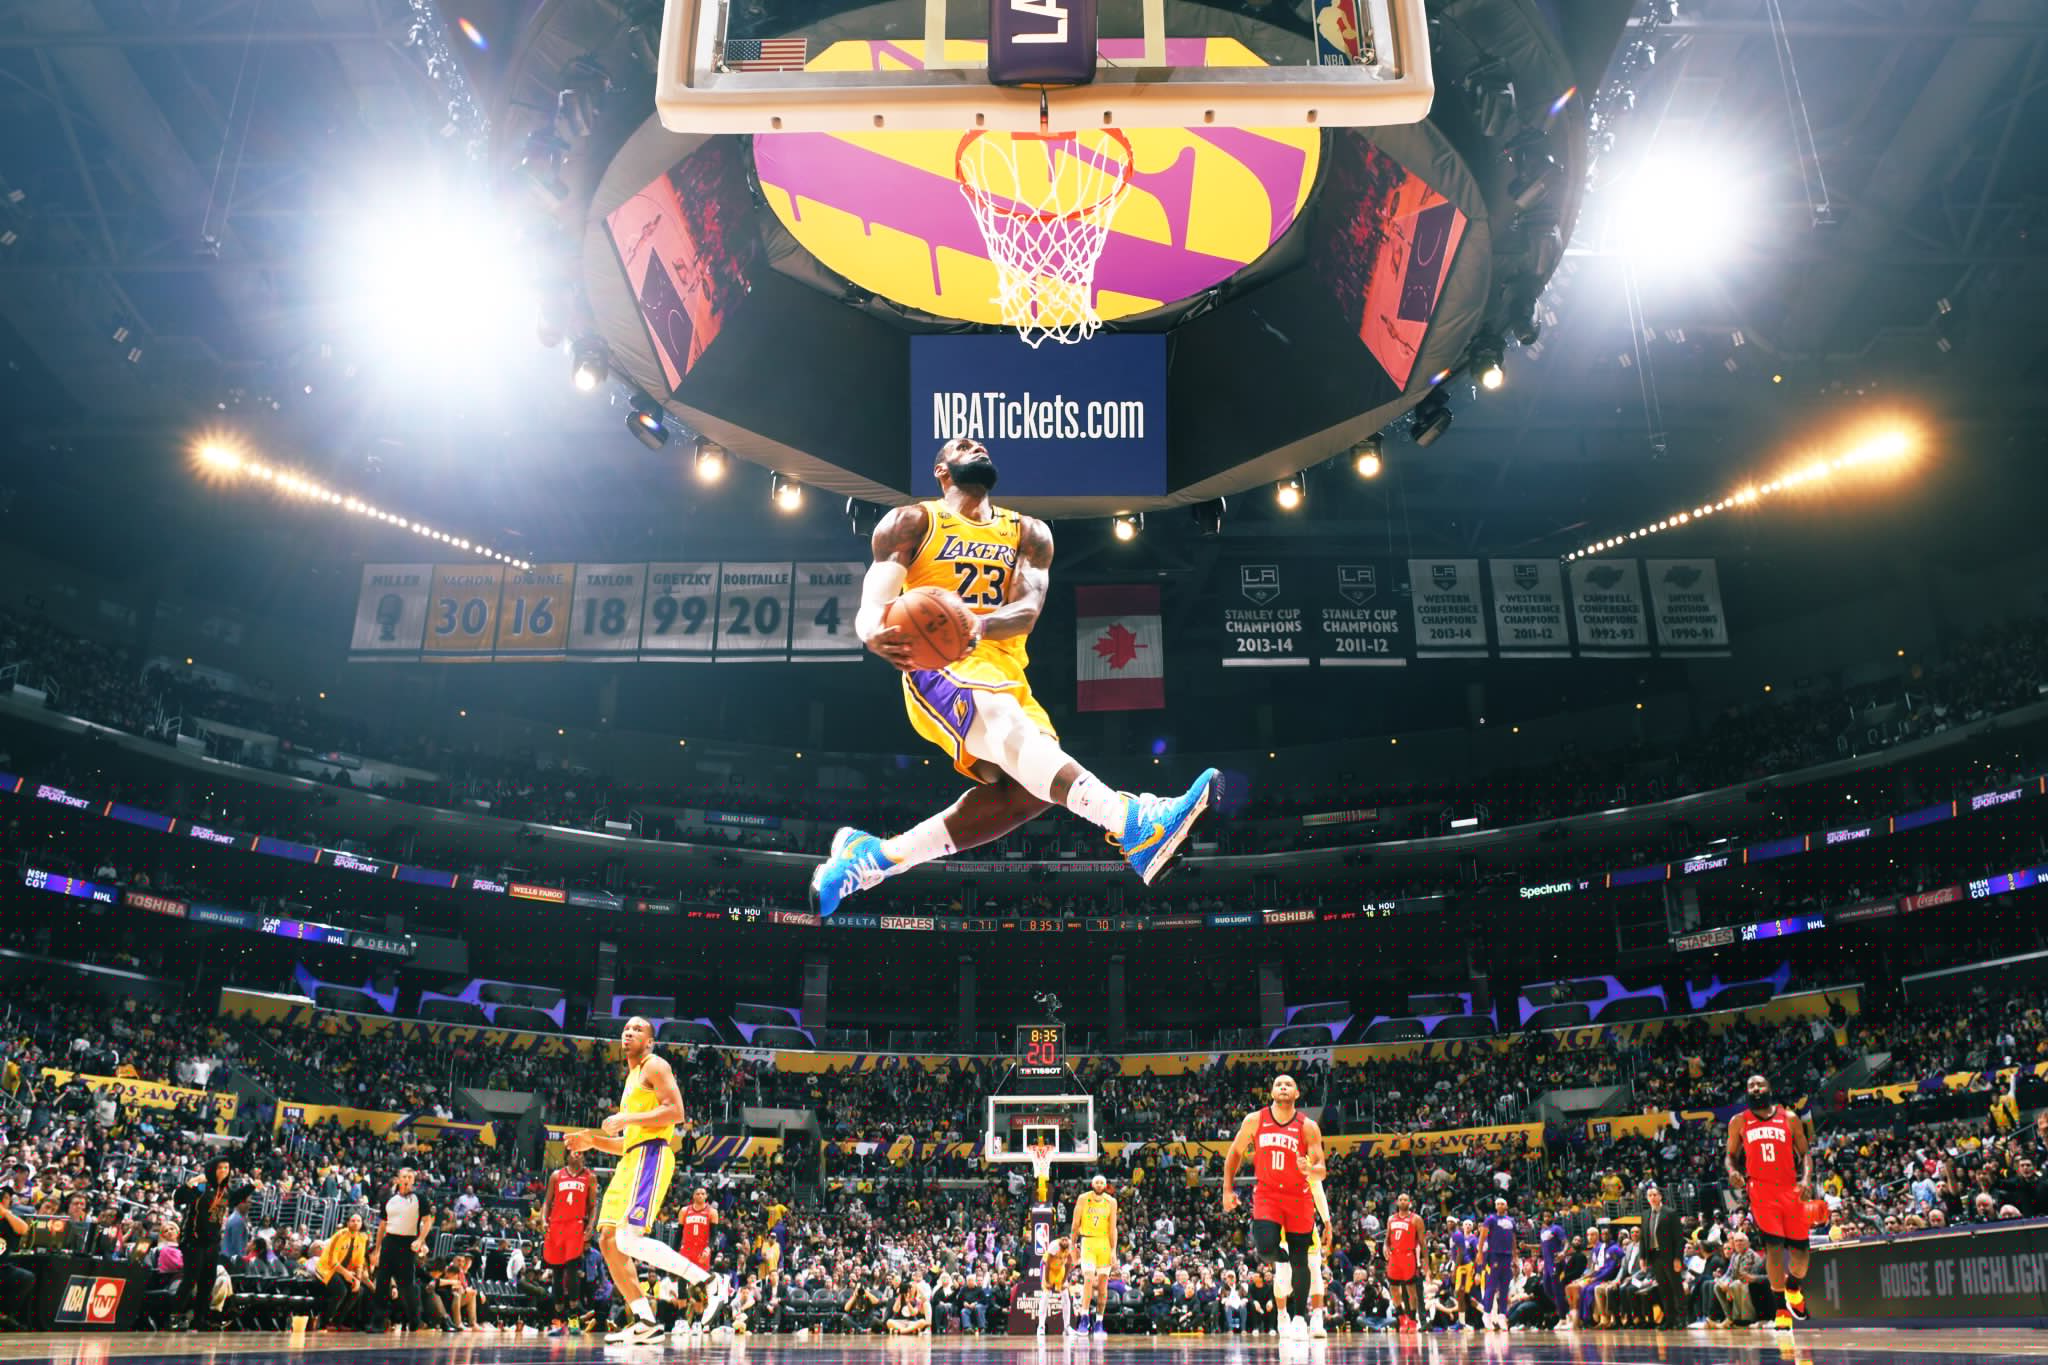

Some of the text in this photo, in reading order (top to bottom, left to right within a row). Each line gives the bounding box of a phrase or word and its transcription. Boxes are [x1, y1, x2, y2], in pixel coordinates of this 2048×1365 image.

[933, 392, 1144, 440] NBATickets.com
[935, 536, 1016, 568] LAKERS
[442, 575, 493, 585] VACHON
[587, 575, 633, 586] TAYLOR
[653, 574, 712, 585] GRETZKY
[724, 574, 789, 585] ROBITAILLE
[810, 574, 853, 585] BLAKE
[1245, 569, 1276, 582] LA
[1342, 569, 1372, 582] LA
[955, 562, 1005, 605] 23
[1423, 594, 1470, 604] WESTERN
[1505, 594, 1552, 603] WESTERN
[1224, 608, 1301, 620] STANLEY CUP
[1322, 608, 1397, 620] STANLEY CUP
[1417, 604, 1480, 614] CONFERENCE
[1500, 604, 1561, 614] CONFERENCE
[1579, 604, 1640, 614] CONFERENCE
[435, 597, 489, 635] 30
[512, 596, 554, 636] 16
[583, 597, 626, 635] 18
[652, 596, 708, 635] 99
[726, 596, 781, 635] 20
[814, 596, 840, 635] 4
[1422, 615, 1478, 625] CHAMPIONS
[1504, 615, 1560, 625] CHAMPIONS
[1583, 615, 1638, 625] CHAMPIONS
[1663, 615, 1718, 625] CHAMPIONS
[1225, 620, 1303, 632] CHAMPIONS
[1323, 620, 1399, 632] CHAMPIONS
[1430, 628, 1472, 639] 2013-14
[1514, 628, 1552, 640] 2011-12
[1591, 628, 1634, 640] 1992-93
[1671, 628, 1714, 640] 1990-91
[1236, 638, 1294, 652] 2013-14
[1336, 638, 1390, 652] 2011-12
[37, 789, 90, 809] SPORTSNET
[1972, 789, 2022, 810] SPORTSNET
[190, 830, 235, 845] SPORTSNET
[1826, 829, 1871, 845] SPORTSNET
[333, 857, 380, 875] SPORTSNET
[1684, 858, 1728, 874] SPORTSNET
[27, 869, 48, 881] NSH
[1520, 882, 1571, 899] Spectrum
[1969, 879, 1989, 890] NSH
[93, 891, 112, 903] NHL
[514, 886, 562, 898] WELLS FARGO
[126, 892, 186, 915] TOSHIBA
[1363, 902, 1395, 912] LAL HOU
[728, 906, 761, 917] LAL HOU
[1265, 911, 1314, 923] TOSHIBA
[838, 917, 877, 926] DELTA
[882, 917, 933, 930] STAPLES
[1231, 916, 1252, 924] LIGHT
[1807, 920, 1826, 930] NHL
[1741, 924, 1758, 933] CAR
[328, 935, 344, 945] NHL
[1678, 931, 1732, 949] STAPLES
[1742, 931, 1756, 941] ARI
[368, 937, 406, 954] DELTA
[1031, 1030, 1057, 1042] 8:35
[1027, 1043, 1055, 1065] 20
[1031, 1067, 1062, 1075] TISSOT
[1746, 1126, 1786, 1144] ROCKETS
[1259, 1132, 1299, 1153] ROCKETS
[1760, 1143, 1775, 1163] 13
[1271, 1150, 1285, 1170] 10
[566, 1192, 573, 1206] 4
[1093, 1216, 1099, 1227] 7
[1880, 1262, 1931, 1299] HOUSE
[1935, 1258, 1955, 1297] OF
[62, 1285, 88, 1312] NBA
